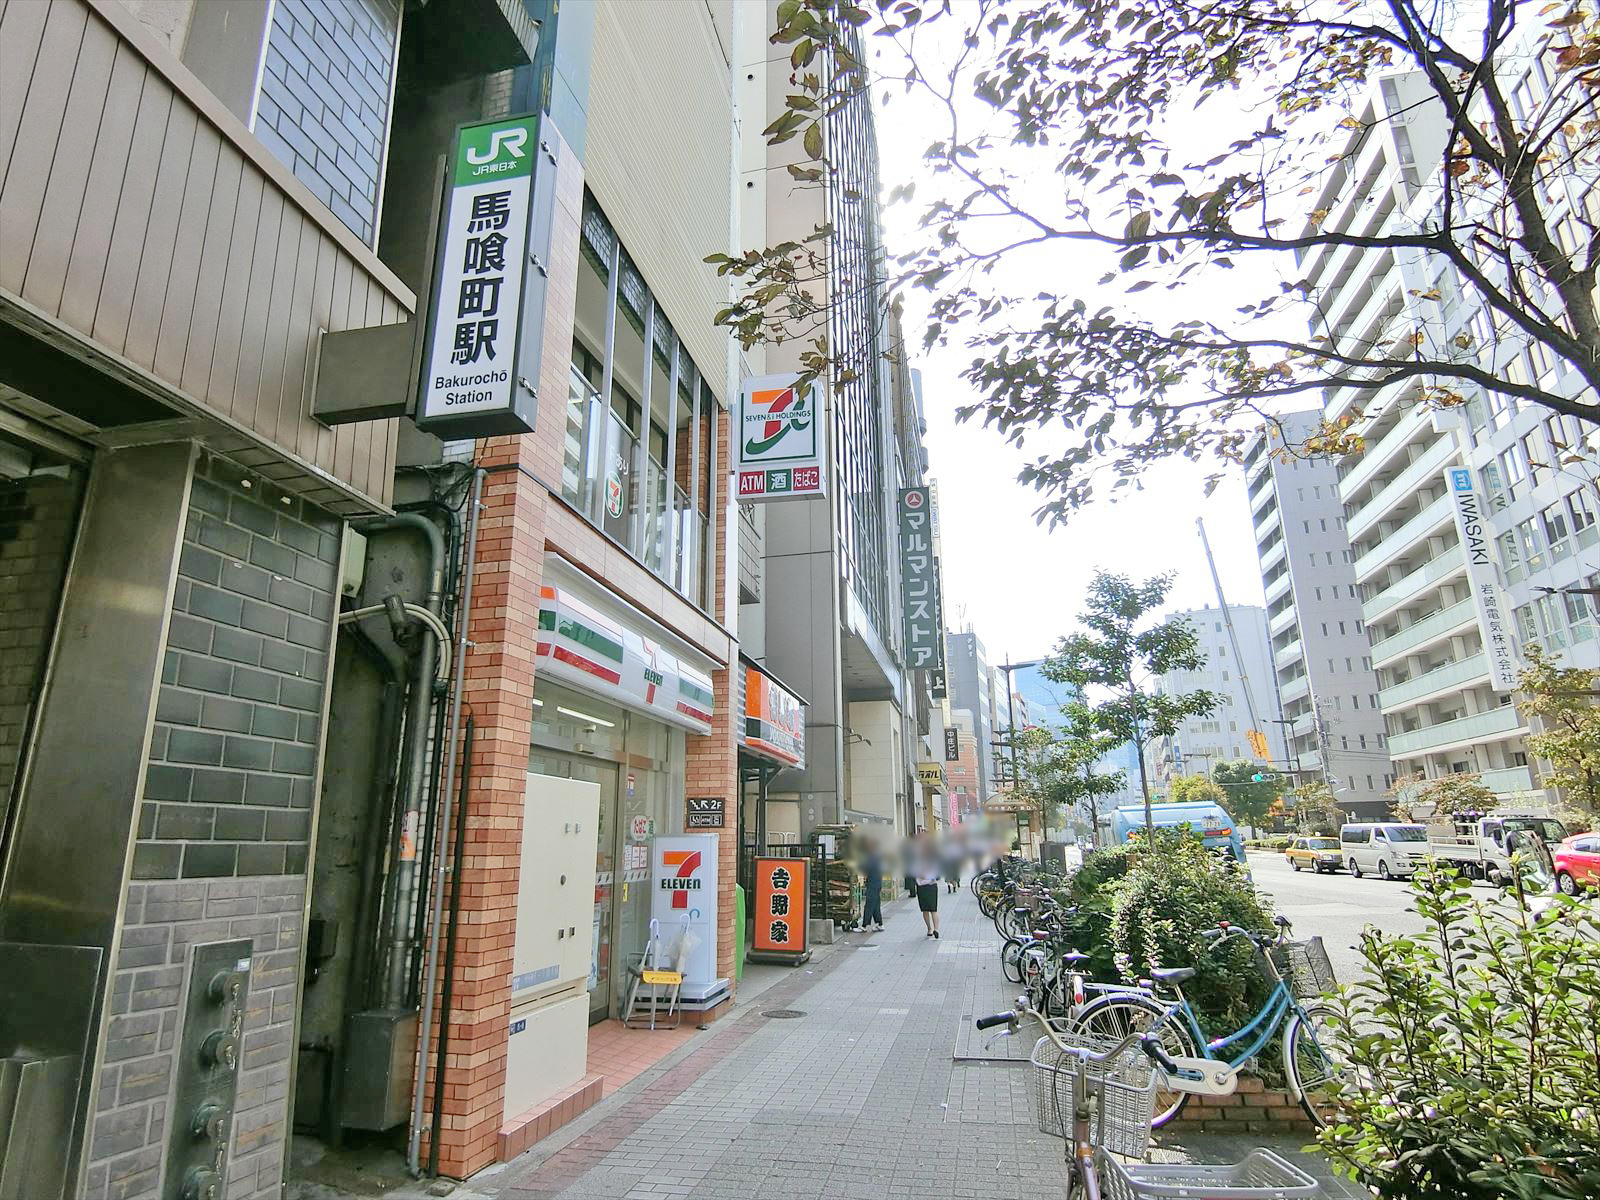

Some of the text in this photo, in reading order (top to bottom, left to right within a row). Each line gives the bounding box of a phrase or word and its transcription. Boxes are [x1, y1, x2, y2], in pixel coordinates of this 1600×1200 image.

[467, 127, 528, 165] JR
[472, 161, 517, 176] JR東日本
[450, 190, 511, 365] 馬喰町駅
[435, 369, 507, 390] Bakurochō
[445, 391, 493, 406] Station
[775, 410, 811, 420] HOLDINGS
[740, 475, 764, 491] ATM
[771, 472, 787, 490] 酒
[794, 470, 818, 487] たばこ
[1458, 494, 1489, 565] IWASAKI
[905, 512, 933, 667] マルマンストア
[1480, 583, 1516, 684] 岩崎電気株式会社
[710, 800, 722, 810] 2F
